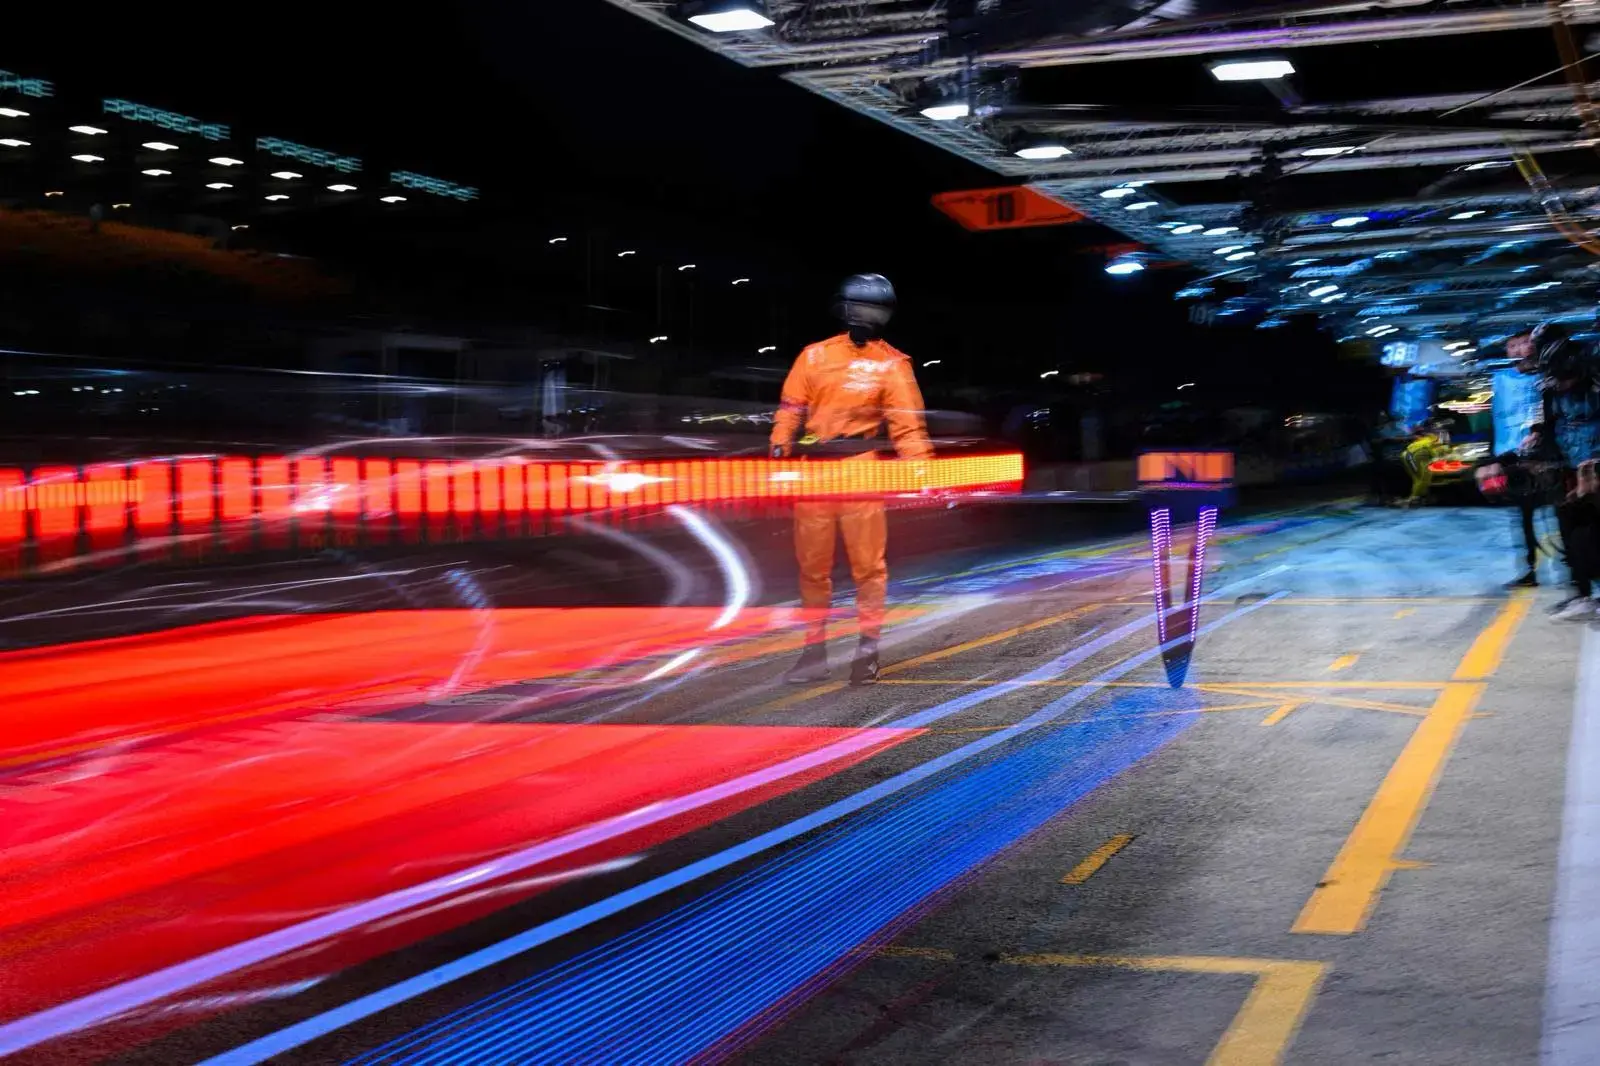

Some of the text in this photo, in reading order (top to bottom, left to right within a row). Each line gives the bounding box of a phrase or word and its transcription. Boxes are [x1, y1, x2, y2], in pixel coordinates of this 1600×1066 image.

[103, 98, 230, 141] PORSCHE
[256, 136, 362, 173] PORSCHE
[390, 170, 479, 201] PORSCHE
